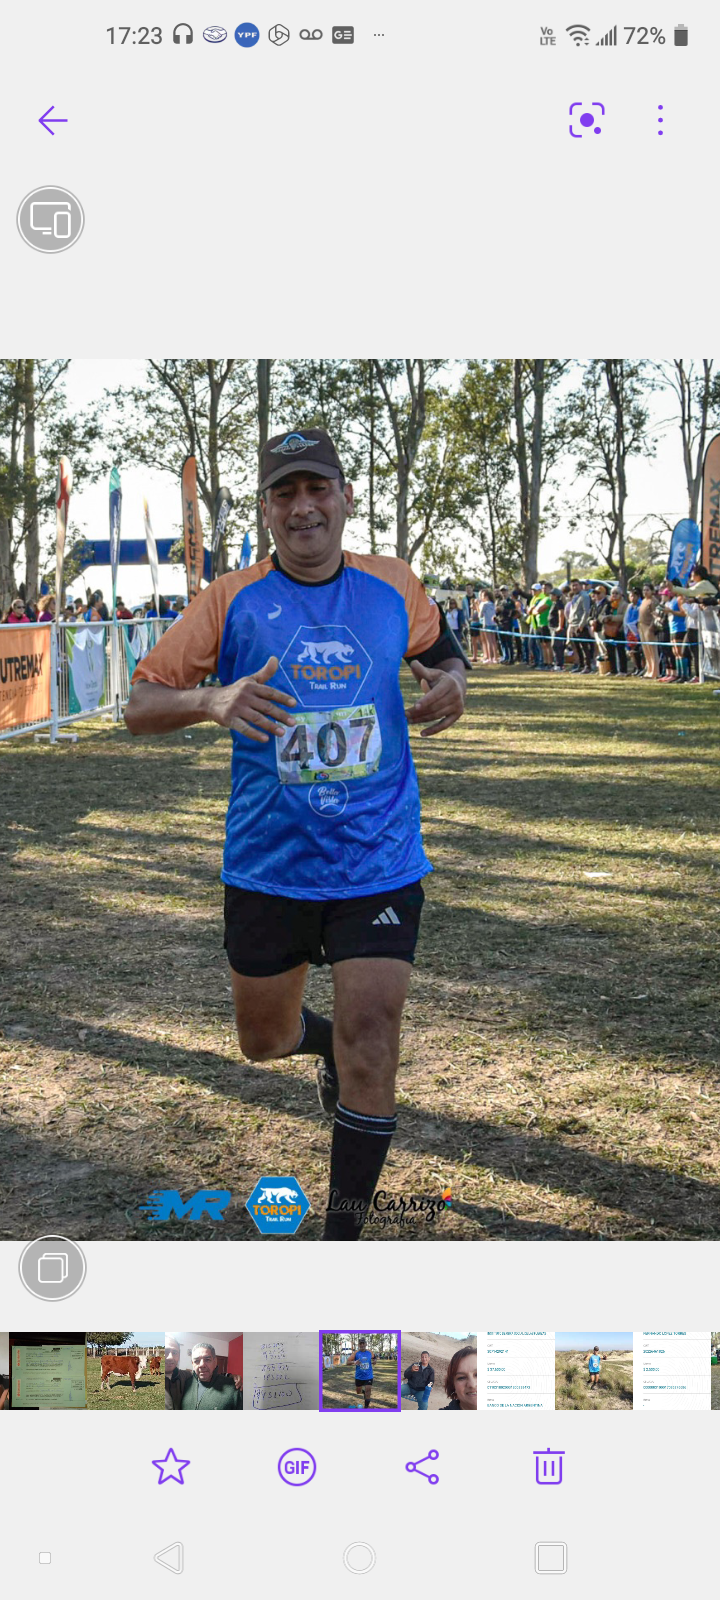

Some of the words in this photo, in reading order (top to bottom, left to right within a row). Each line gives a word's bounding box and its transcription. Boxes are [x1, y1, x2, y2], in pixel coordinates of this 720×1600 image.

[106, 26, 162, 45] 17:23
[540, 36, 556, 46] LTE
[623, 26, 666, 45] 72%
[290, 664, 362, 681] TOROPI
[280, 717, 376, 769] 407
[284, 1460, 310, 1475] GIF
